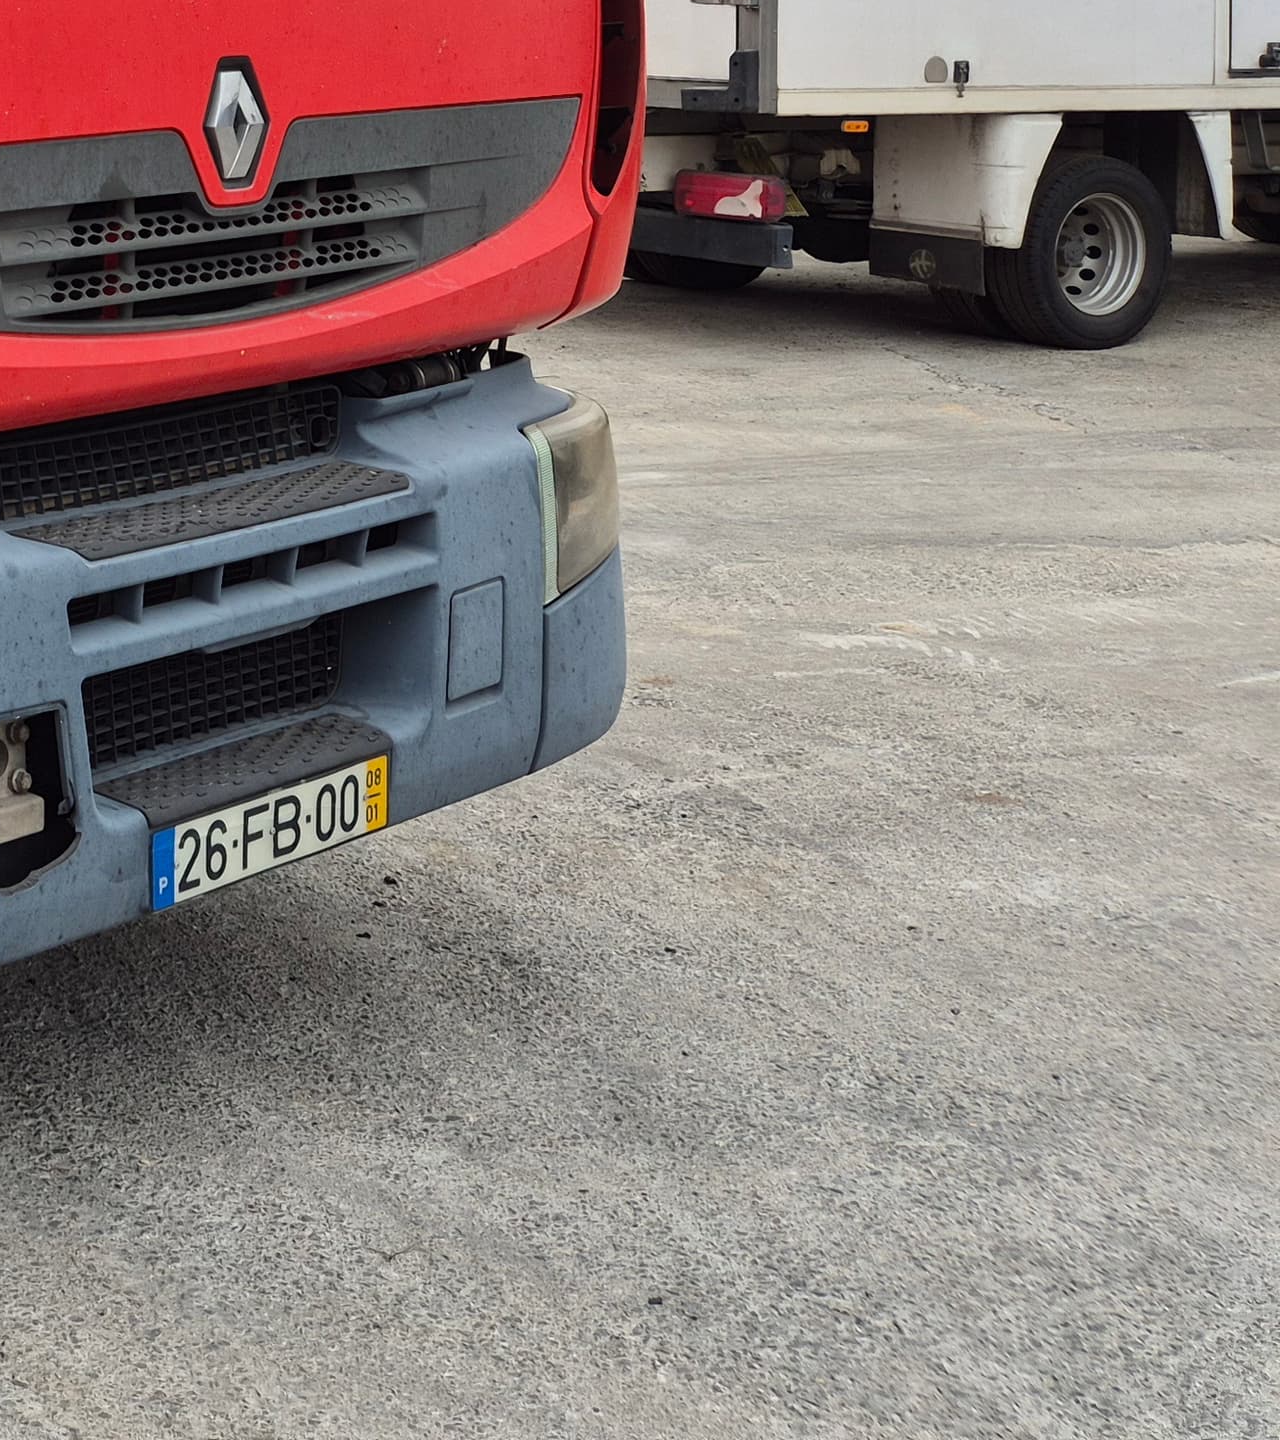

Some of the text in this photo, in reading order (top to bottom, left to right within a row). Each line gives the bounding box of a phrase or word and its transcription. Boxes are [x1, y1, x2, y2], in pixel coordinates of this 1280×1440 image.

[366, 768, 381, 788] 08
[366, 804, 378, 823] 01
[159, 877, 168, 894] P
